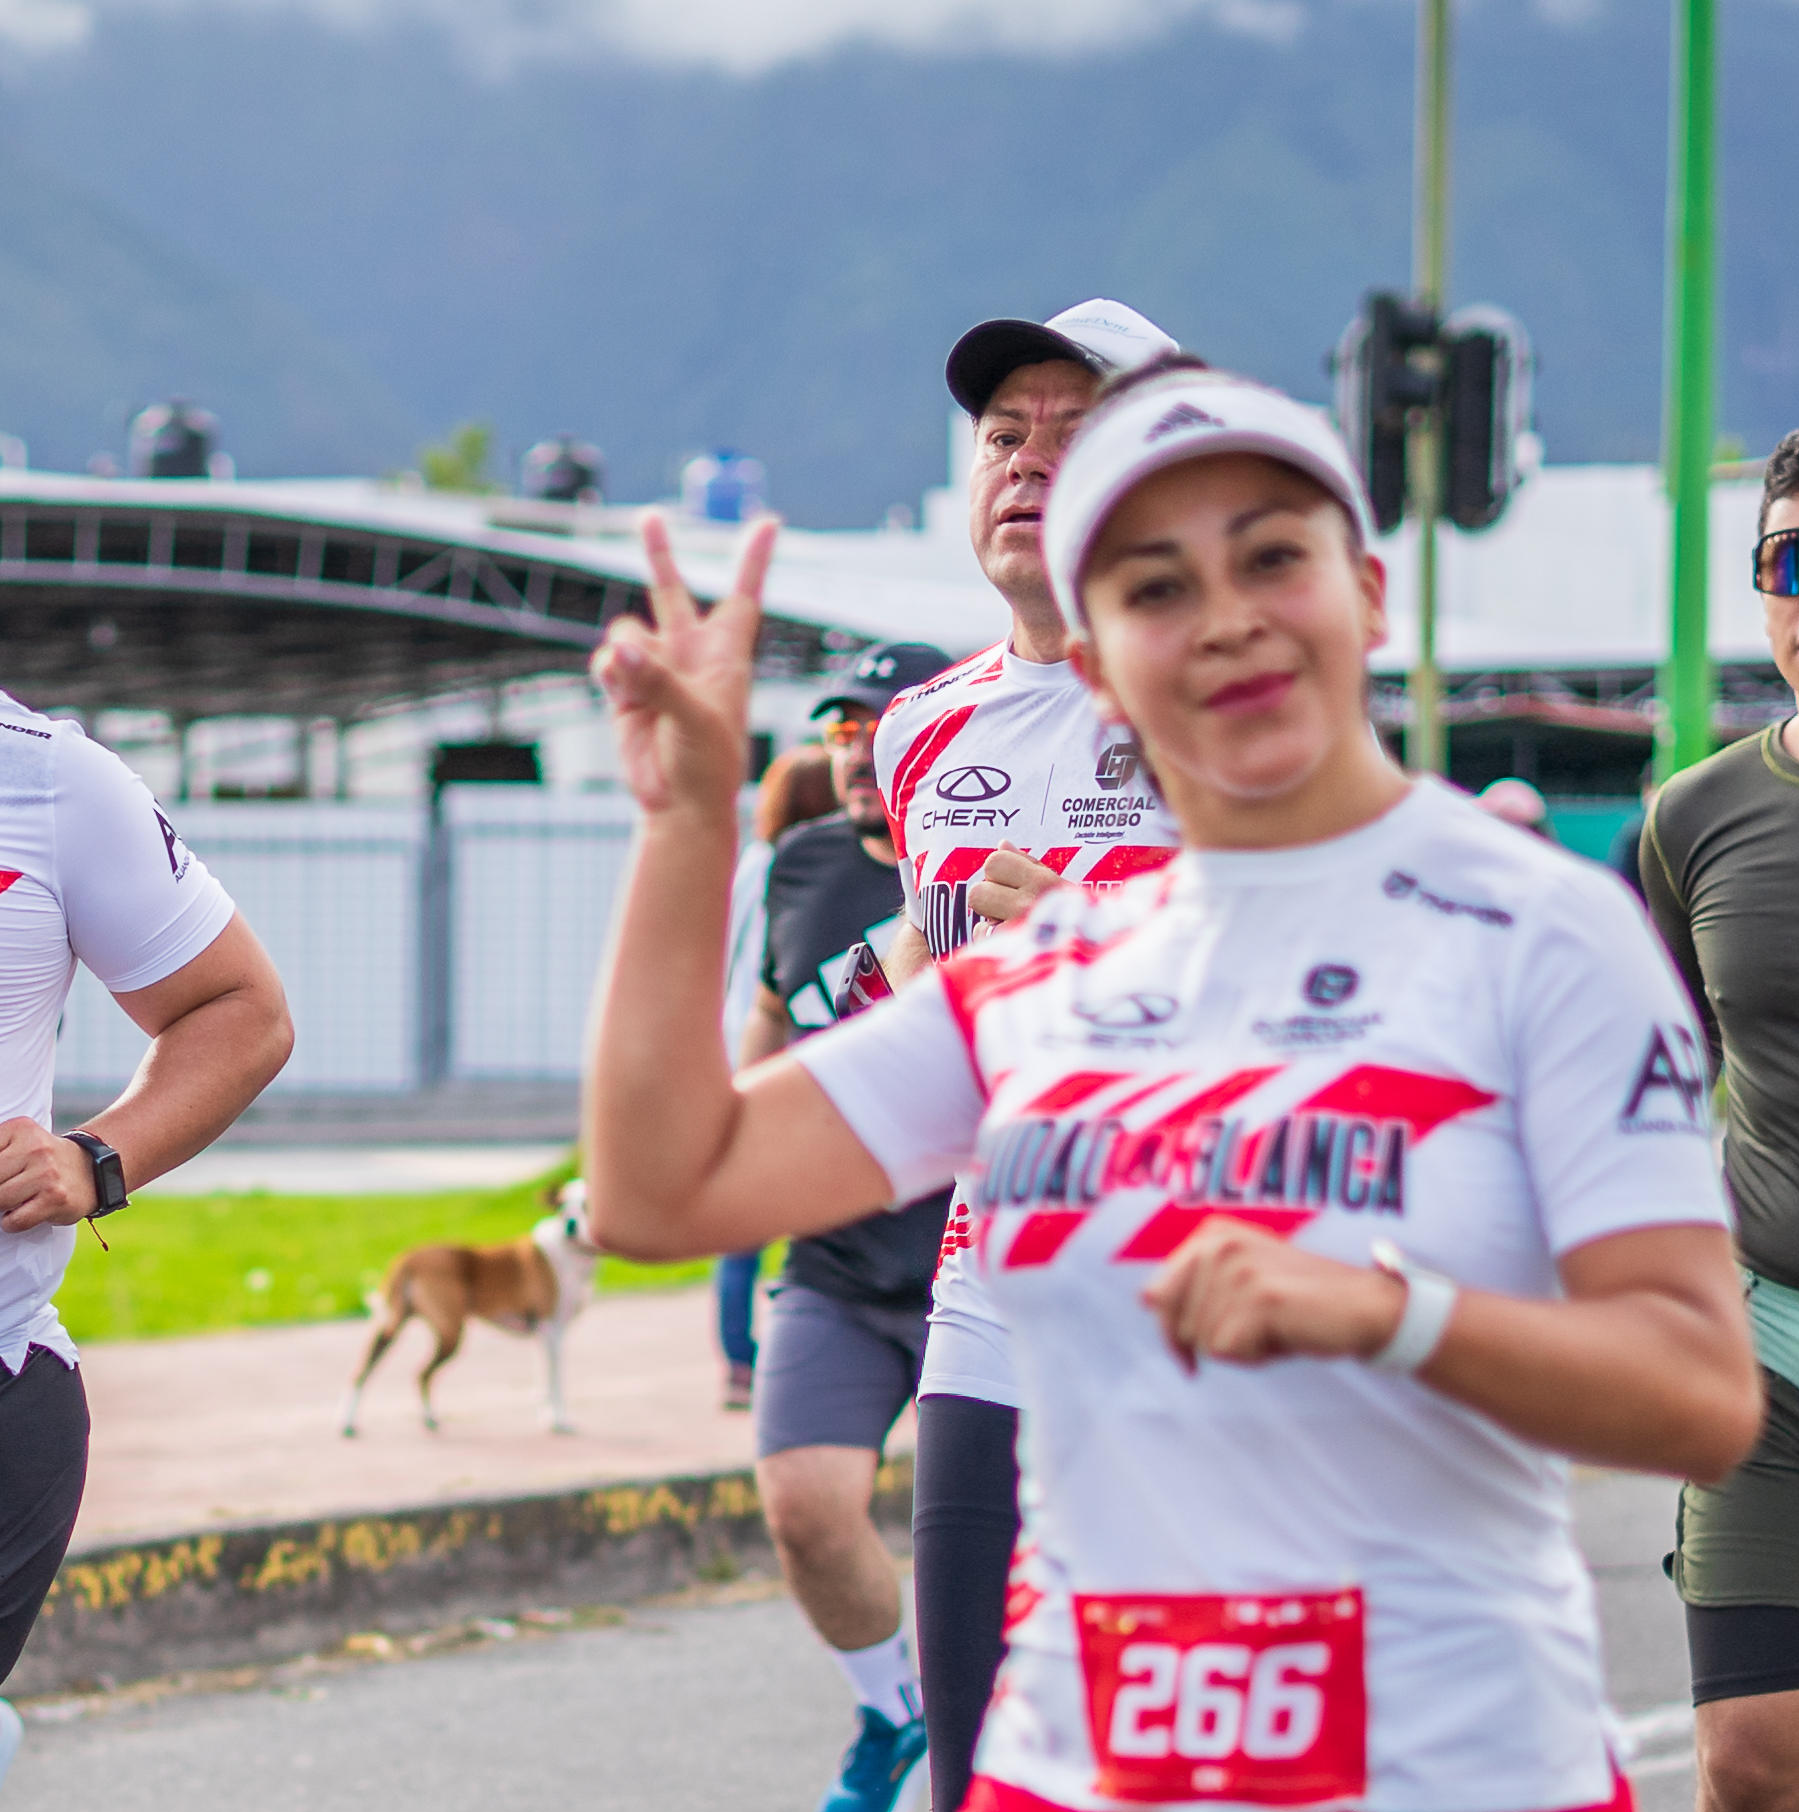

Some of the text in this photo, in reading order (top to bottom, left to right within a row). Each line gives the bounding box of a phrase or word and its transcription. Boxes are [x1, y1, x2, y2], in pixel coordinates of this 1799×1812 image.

[1062, 796, 1156, 813] COMERCIAL
[922, 808, 1021, 830] CHERY
[1068, 813, 1141, 828] HIDROBO
[1108, 1641, 1332, 1761] 266
